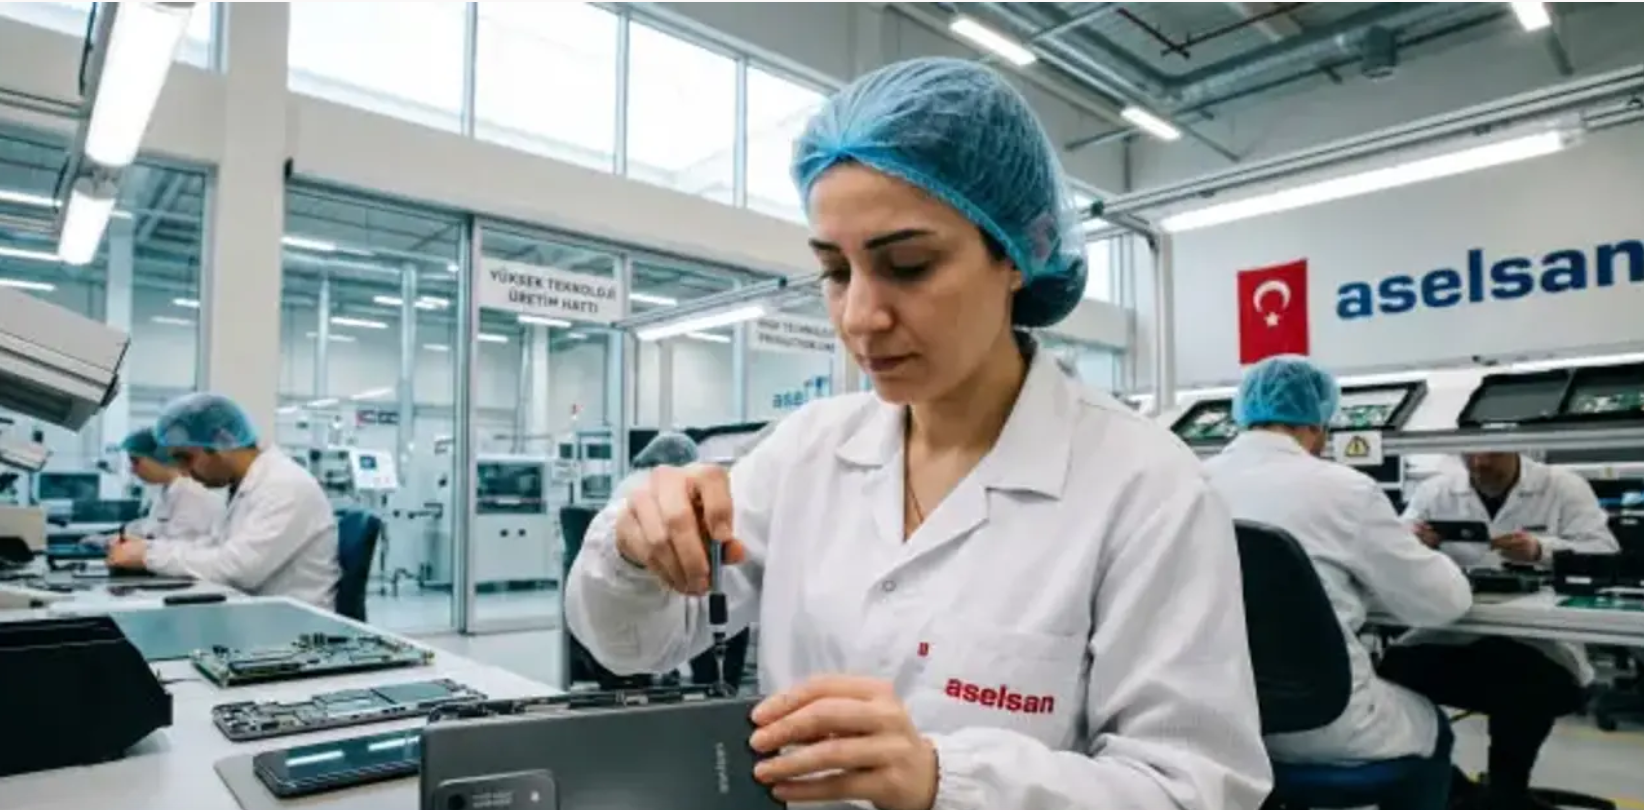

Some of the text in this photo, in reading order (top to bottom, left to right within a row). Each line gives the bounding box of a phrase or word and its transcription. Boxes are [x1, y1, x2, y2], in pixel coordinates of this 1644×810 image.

[489, 267, 542, 288] YÜKSEK
[1336, 239, 1644, 320] aselsan
[945, 677, 1055, 714] aselsan
